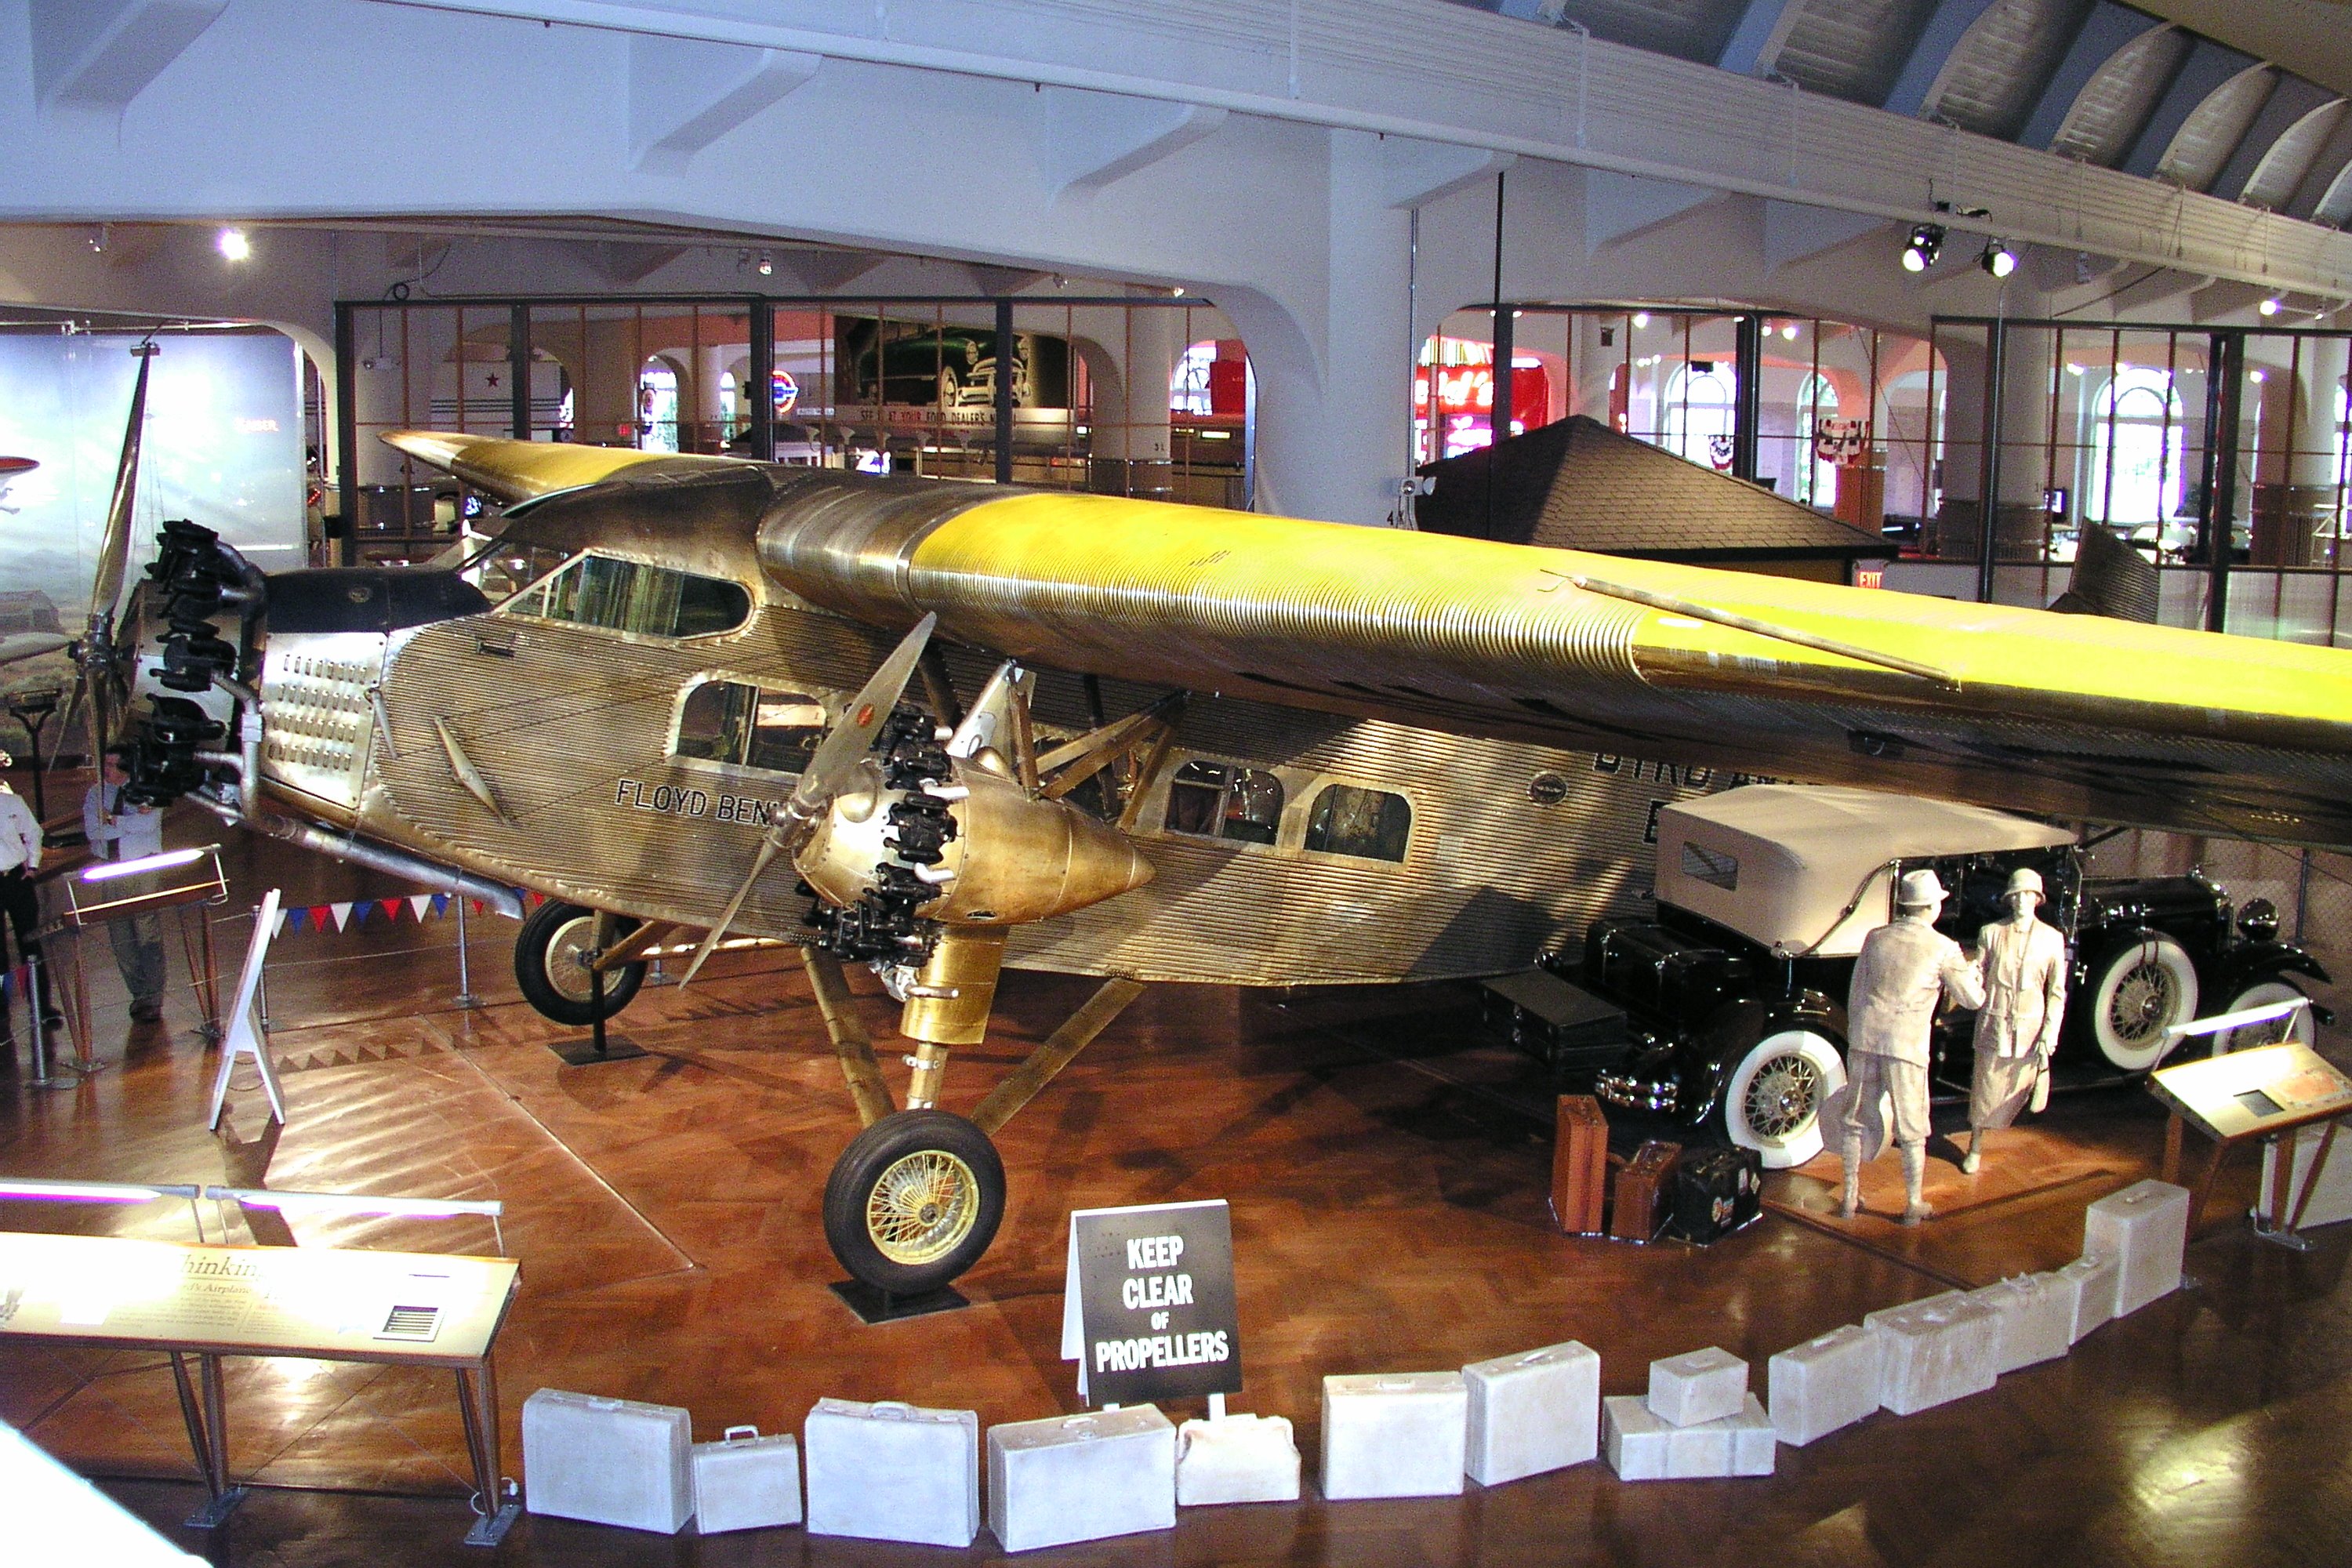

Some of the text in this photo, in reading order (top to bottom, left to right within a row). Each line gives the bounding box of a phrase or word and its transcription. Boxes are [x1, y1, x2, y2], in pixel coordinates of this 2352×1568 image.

[951, 412, 985, 426] DEALER'S
[1859, 572, 1882, 588] EXIT
[615, 778, 778, 828] FLOYD BEN
[180, 1254, 263, 1280] hinkin
[1127, 1235, 1184, 1269] KEEP
[1123, 1274, 1194, 1309] CLEAR
[1151, 1312, 1170, 1330] OF
[1095, 1330, 1229, 1372] PROPELLERS
